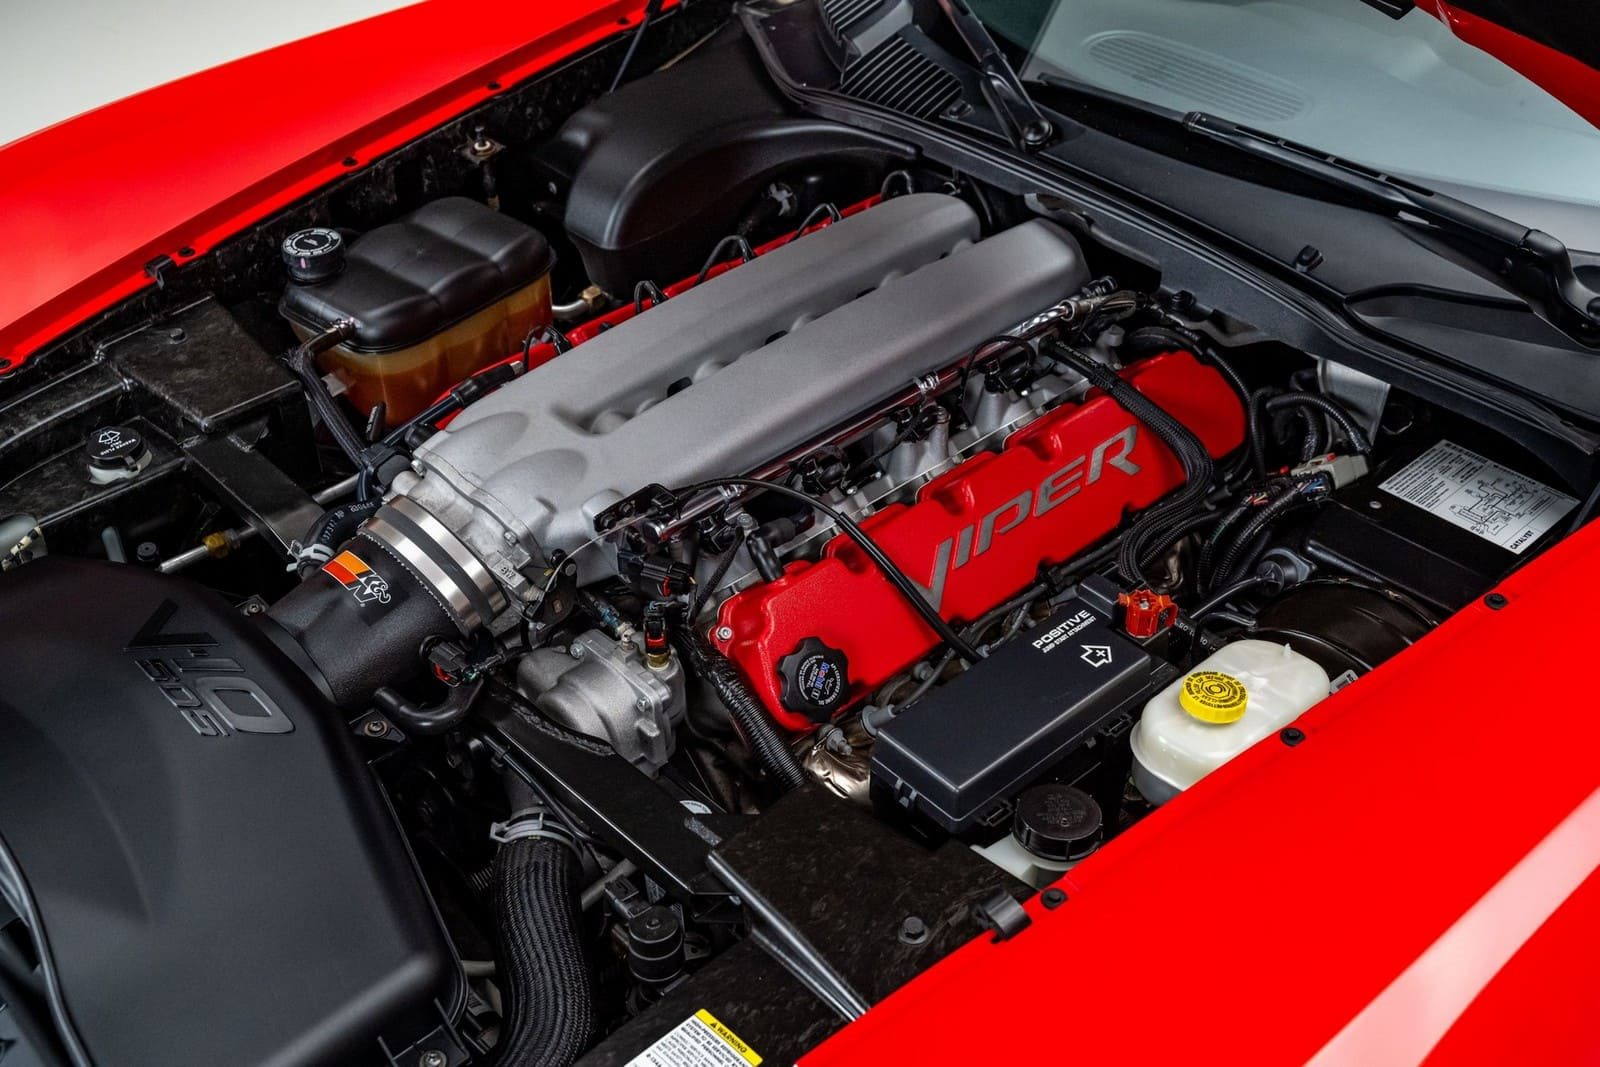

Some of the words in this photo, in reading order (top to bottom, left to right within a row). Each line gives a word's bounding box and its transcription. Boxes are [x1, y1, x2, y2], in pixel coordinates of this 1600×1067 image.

[905, 425, 1142, 613] VIPER
[1032, 610, 1091, 648] POSITIVE
[133, 658, 231, 737] 505
[716, 1027, 747, 1053] WARNING
